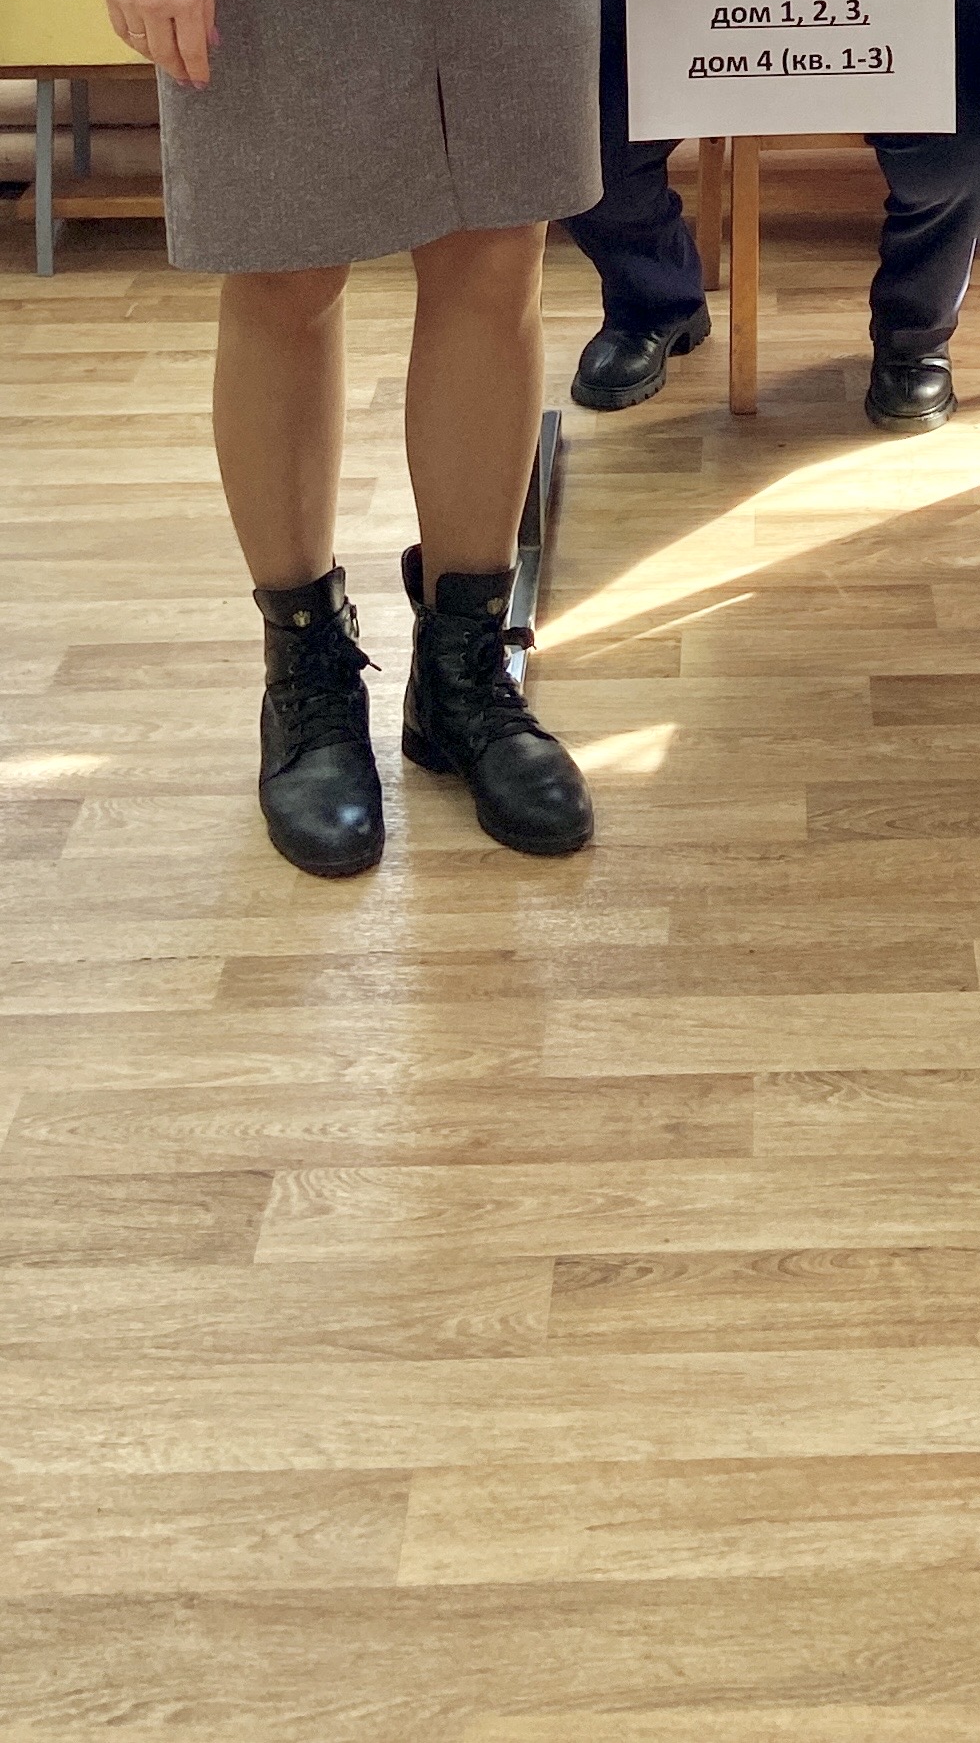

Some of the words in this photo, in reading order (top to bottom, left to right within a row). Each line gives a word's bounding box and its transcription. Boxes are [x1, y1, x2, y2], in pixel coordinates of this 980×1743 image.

[711, 6, 771, 28] дом
[780, 0, 803, 25] 1,
[813, 0, 837, 25] 2,
[688, 55, 749, 78] дом
[756, 50, 773, 72] 4
[782, 47, 831, 75] (кв.
[841, 45, 893, 74] 1-3)
